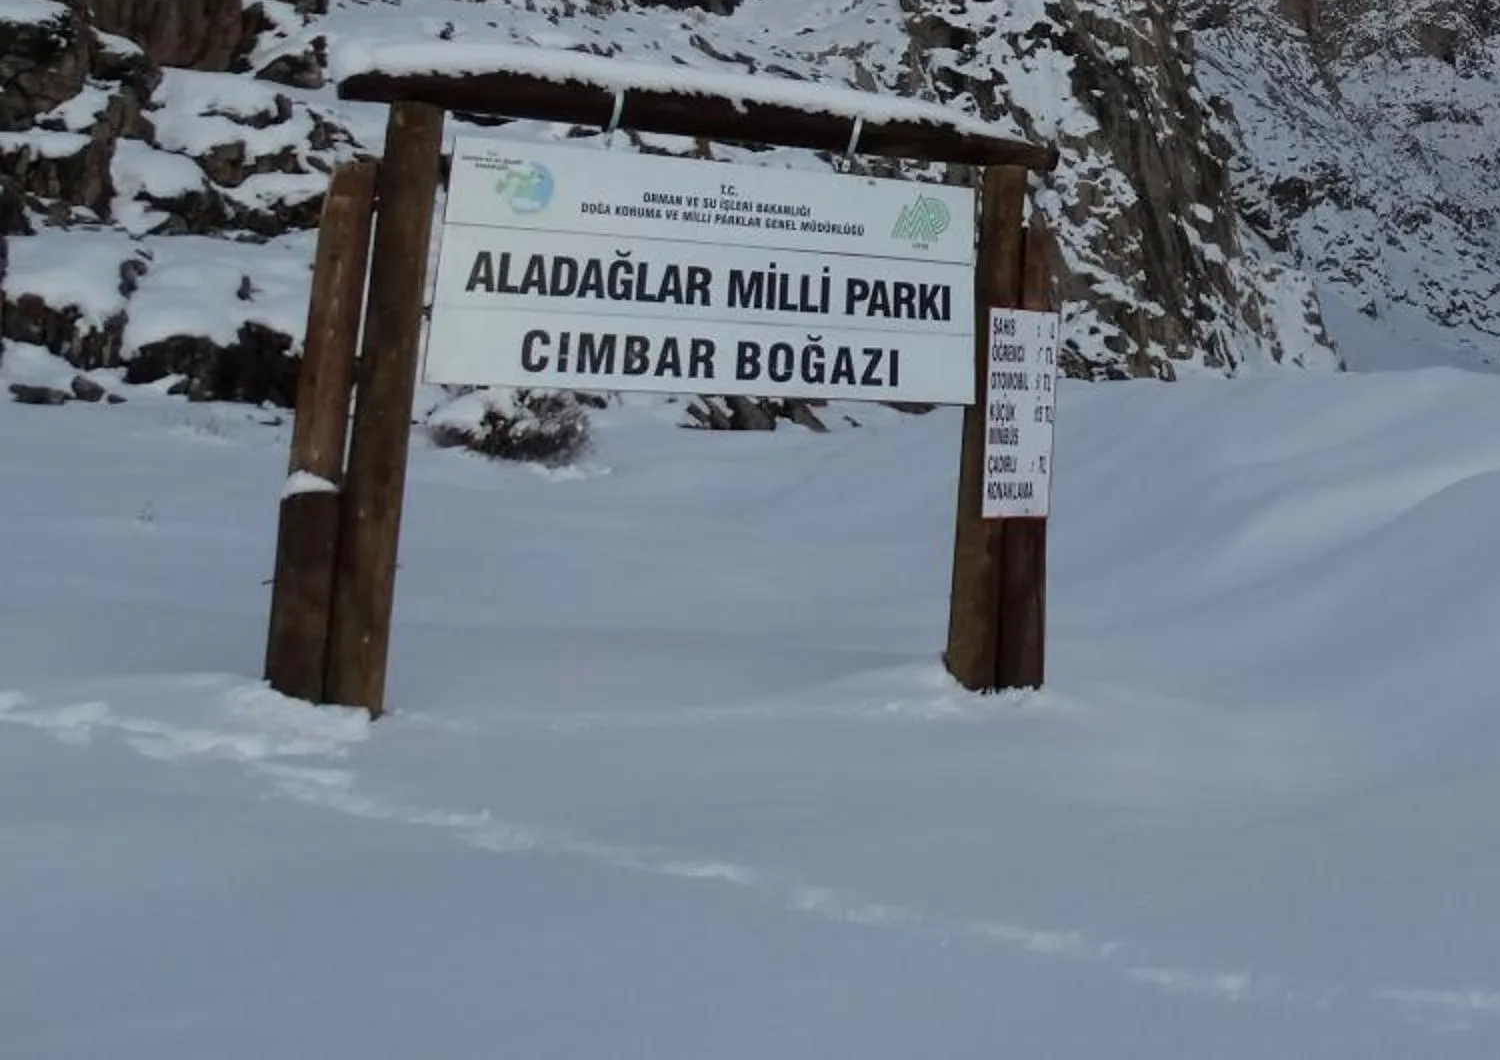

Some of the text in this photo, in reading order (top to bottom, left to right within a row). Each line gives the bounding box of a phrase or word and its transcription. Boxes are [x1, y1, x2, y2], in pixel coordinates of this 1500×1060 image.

[615, 204, 662, 219] KORUMA
[665, 209, 679, 220] VE
[715, 213, 761, 228] PARKLAR
[765, 218, 797, 231] GENEL
[643, 192, 682, 206] ORMAN
[685, 196, 699, 207] VE
[703, 197, 717, 209] SU
[464, 249, 951, 321] ALADAĞLAR MİLLİ PARKI
[735, 334, 899, 387] BOĞAZI
